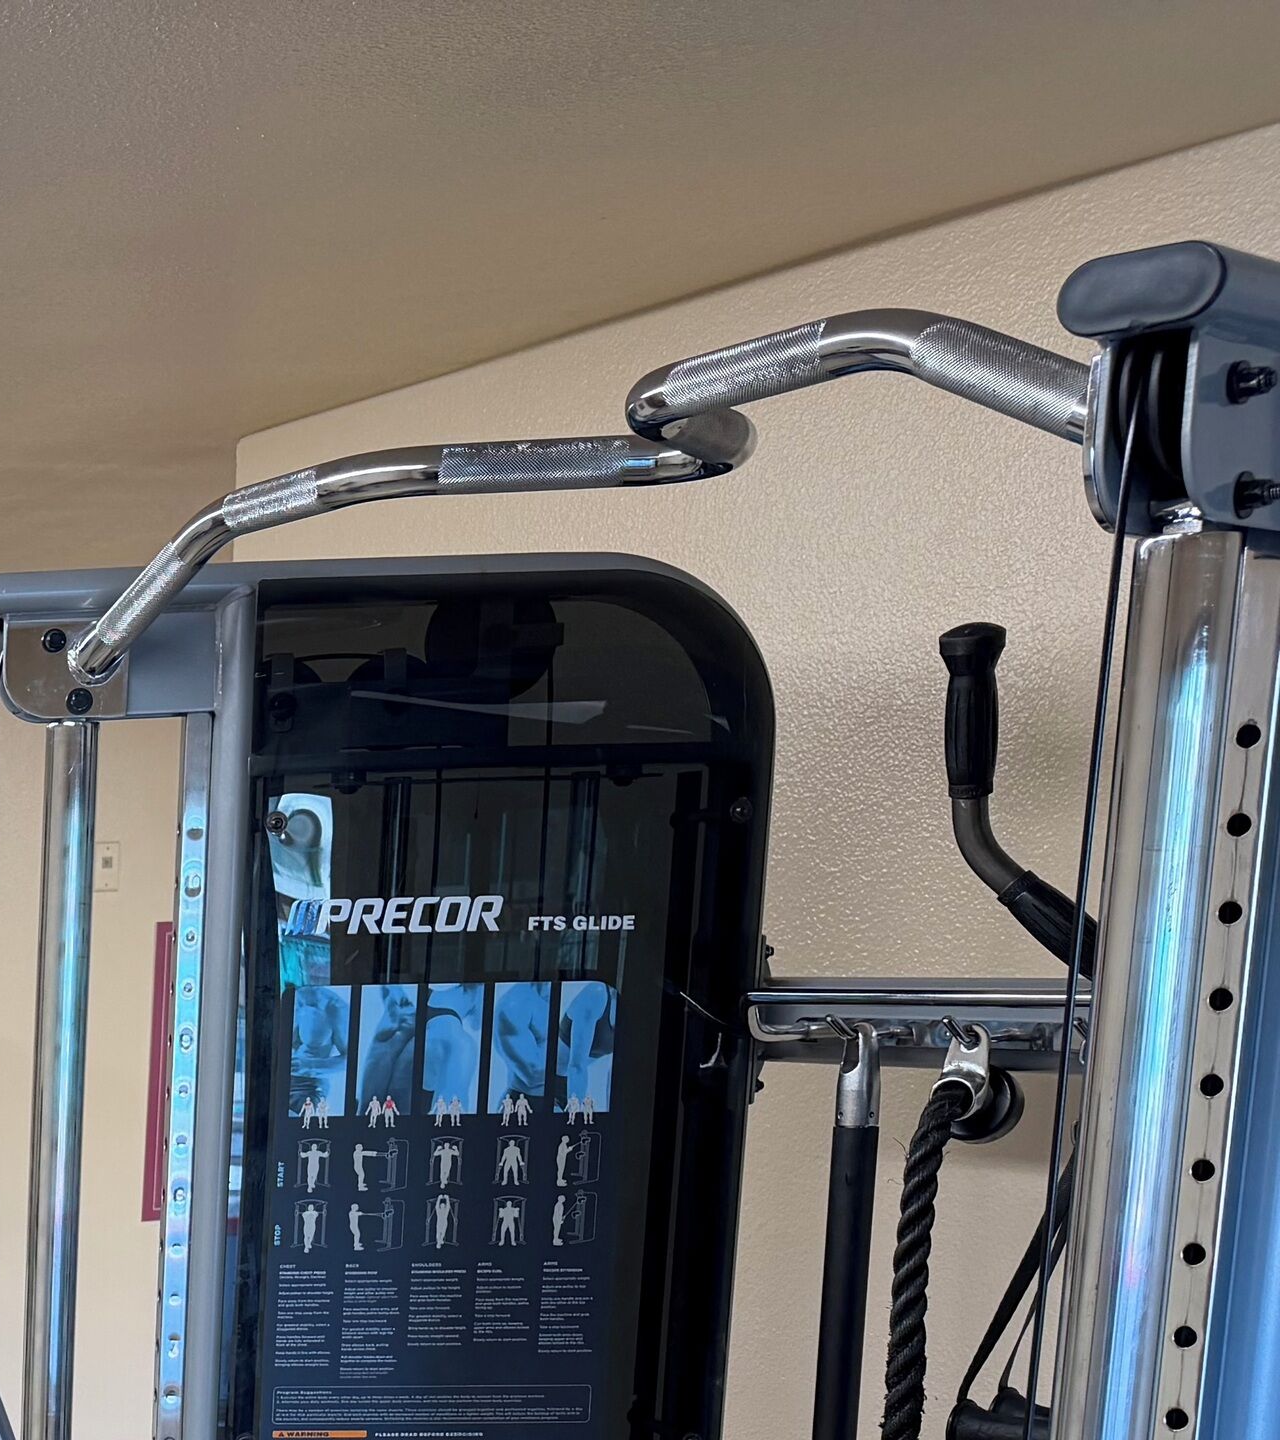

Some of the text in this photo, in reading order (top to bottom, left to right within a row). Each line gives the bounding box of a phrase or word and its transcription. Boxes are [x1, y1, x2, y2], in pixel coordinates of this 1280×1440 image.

[316, 895, 636, 935] PRECOR FTS GLIDE
[277, 1161, 285, 1188] START
[274, 1224, 282, 1246] STOP
